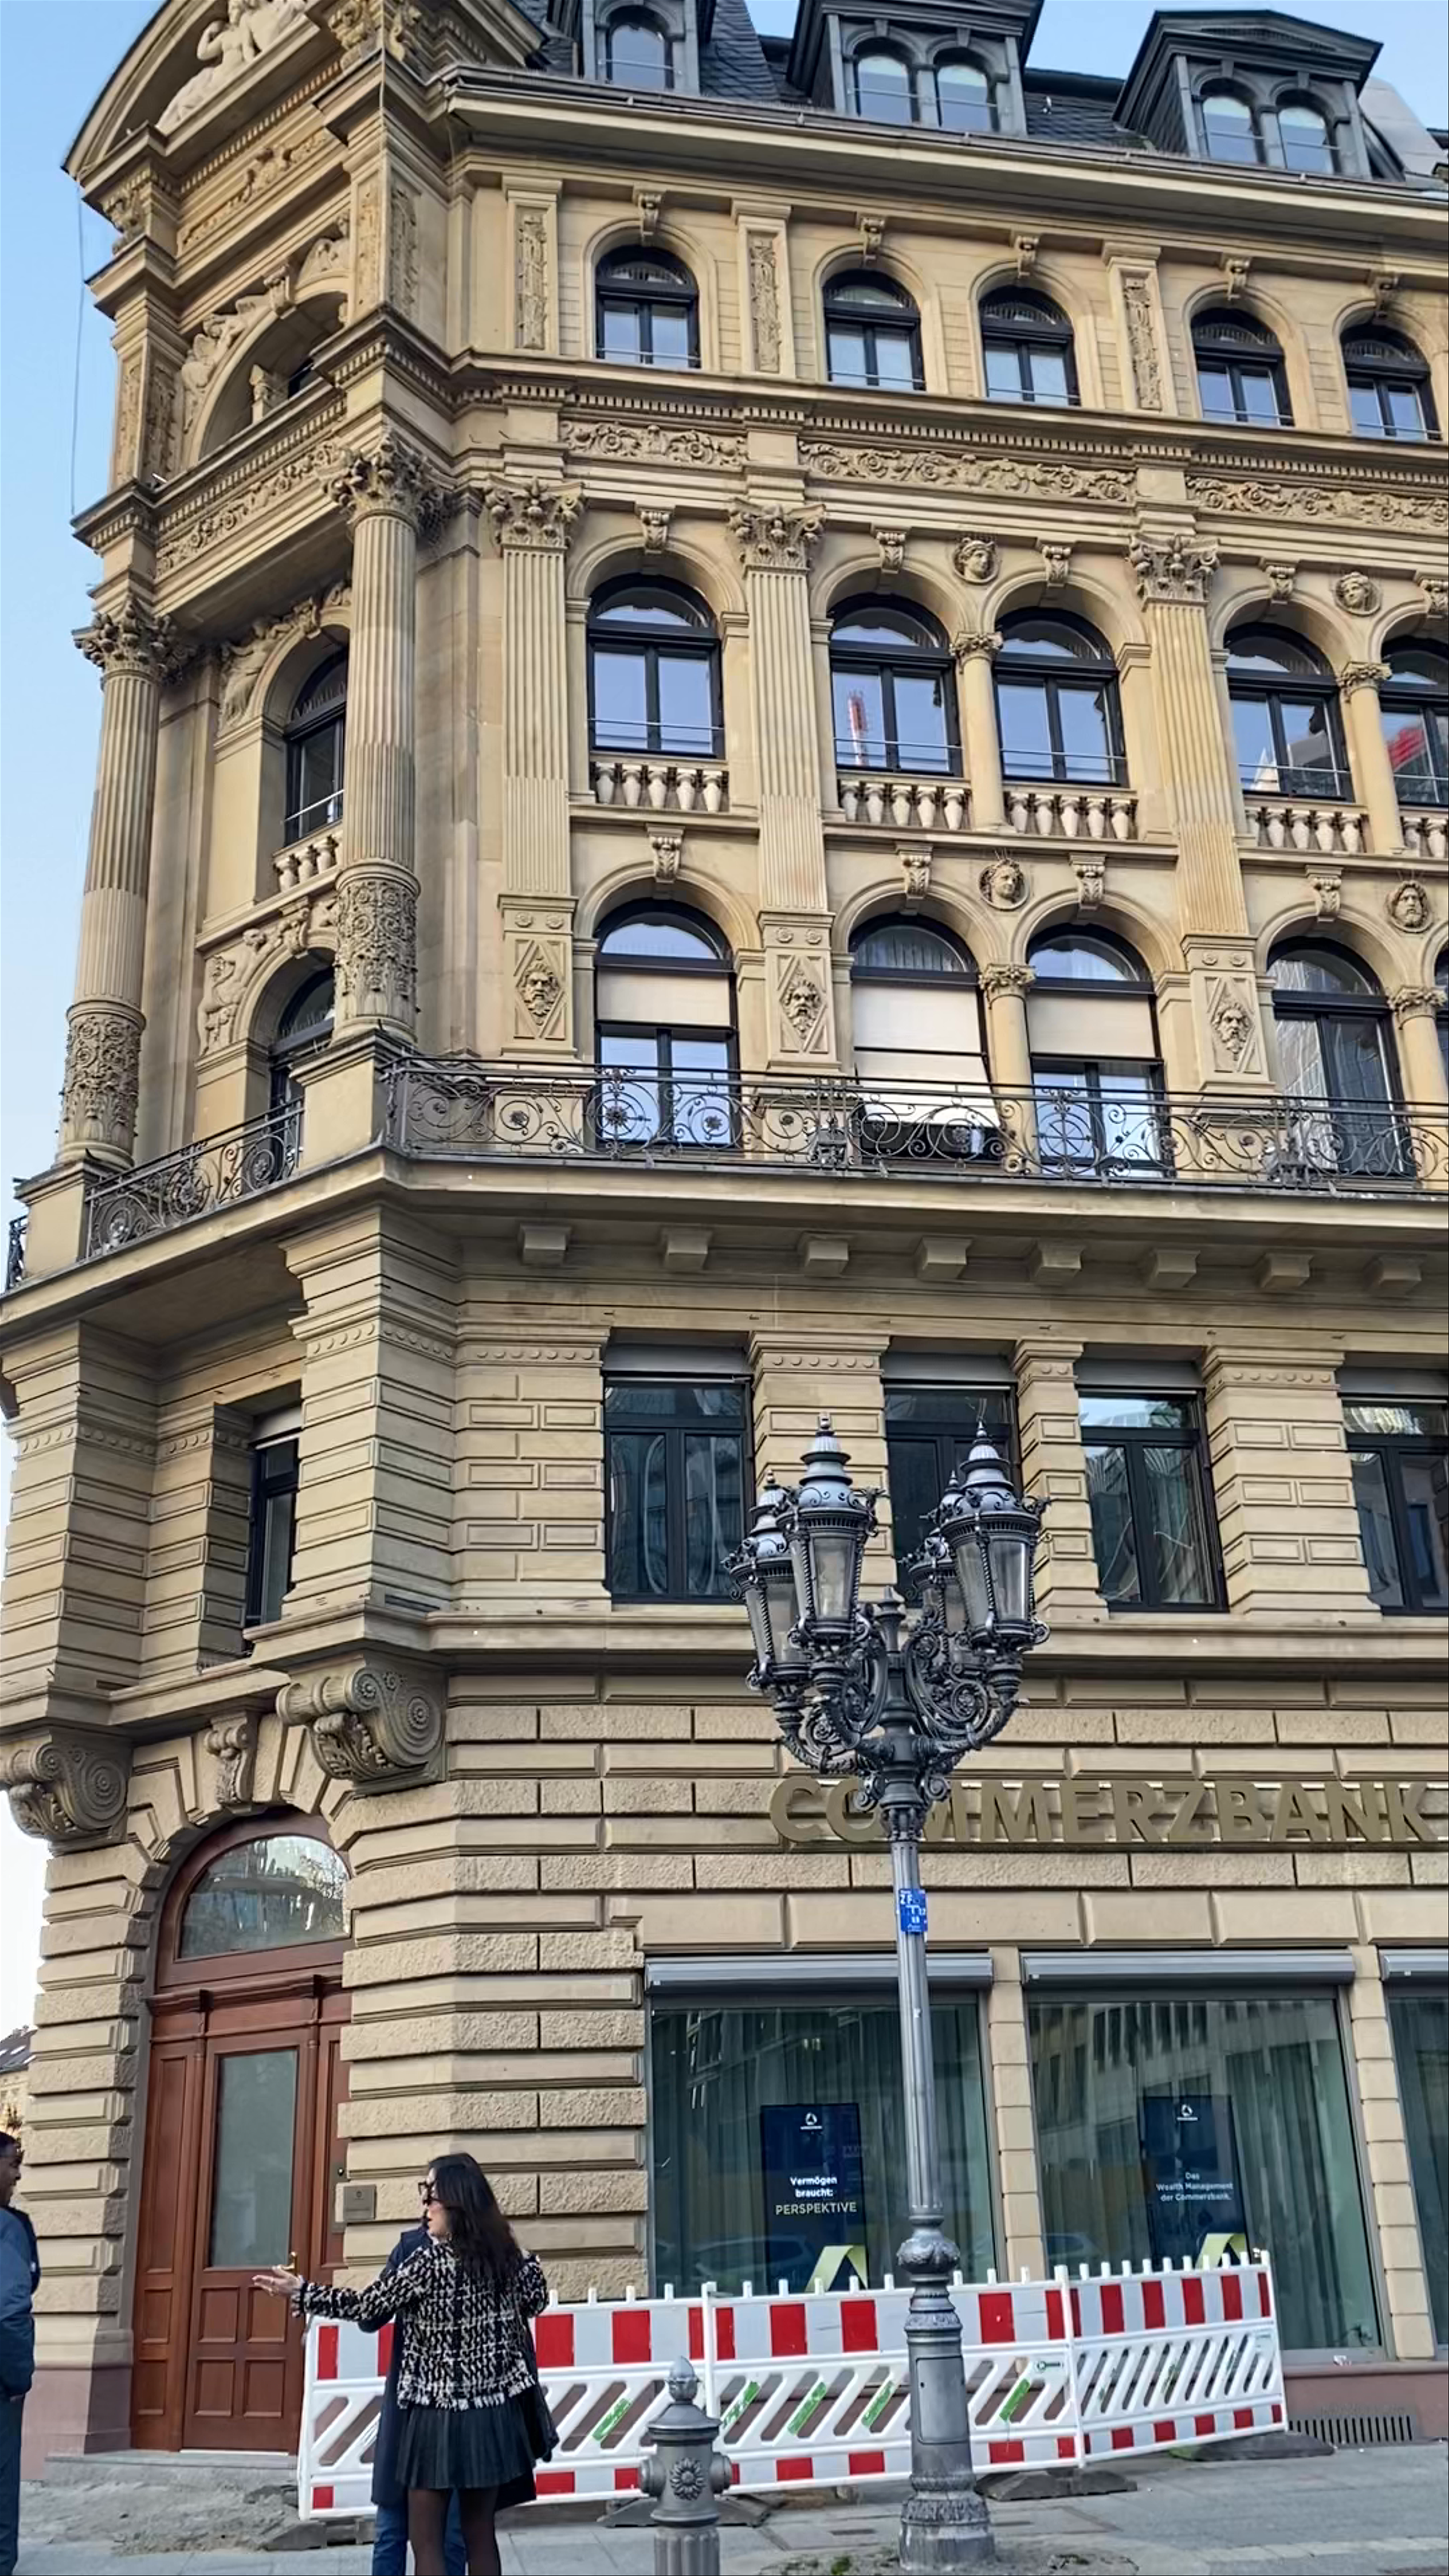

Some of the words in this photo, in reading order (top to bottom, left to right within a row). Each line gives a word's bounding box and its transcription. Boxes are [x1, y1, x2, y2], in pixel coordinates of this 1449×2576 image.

[789, 2175, 838, 2186] Vermögen
[1185, 2172, 1200, 2180] Das
[1185, 2182, 1233, 2191] Management
[795, 2188, 834, 2198] braucht:
[1160, 2194, 1174, 2202] der
[775, 2201, 857, 2215] PERSPEKTIVE
